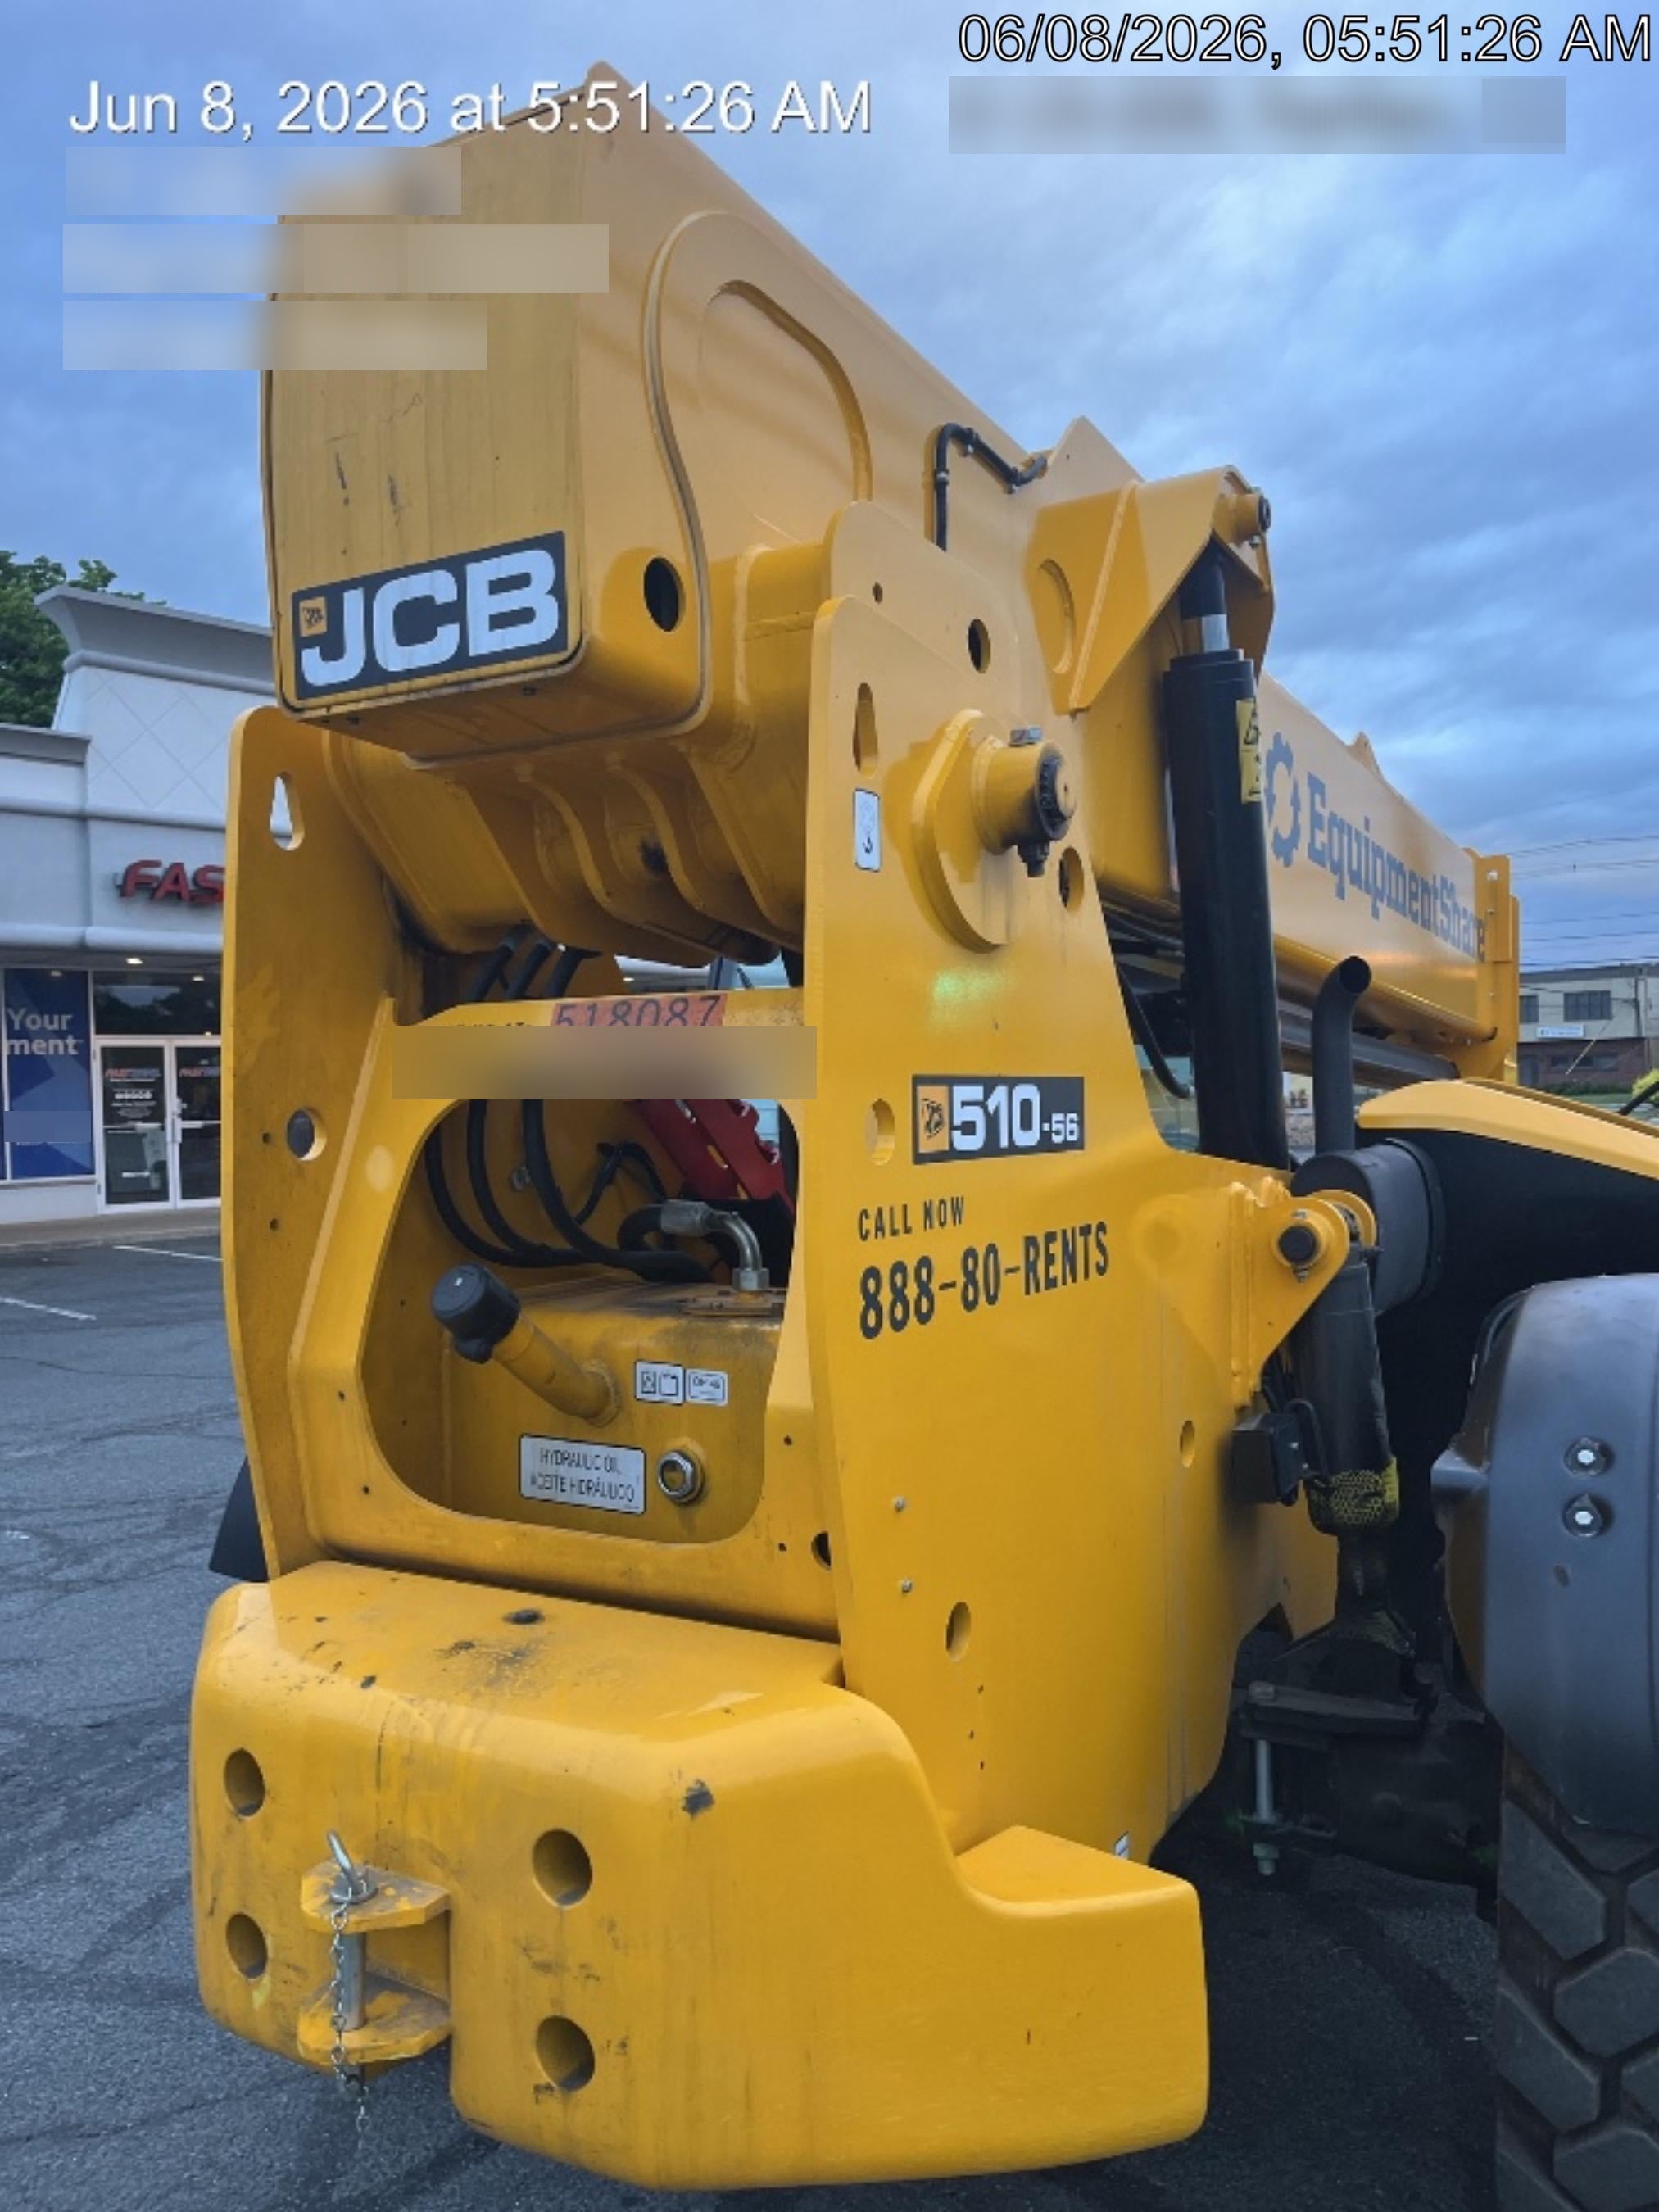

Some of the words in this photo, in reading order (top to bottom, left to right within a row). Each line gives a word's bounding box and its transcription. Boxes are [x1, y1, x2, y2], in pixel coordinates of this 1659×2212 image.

[301, 549, 560, 687] JCB
[1307, 772, 1487, 963] EquipmentShare
[7, 1007, 74, 1031] Your
[951, 1083, 1080, 1152] 510-56
[858, 1203, 913, 1242] CALL
[923, 1196, 965, 1232] NOW
[859, 1221, 1110, 1340] 888-80-RENTS
